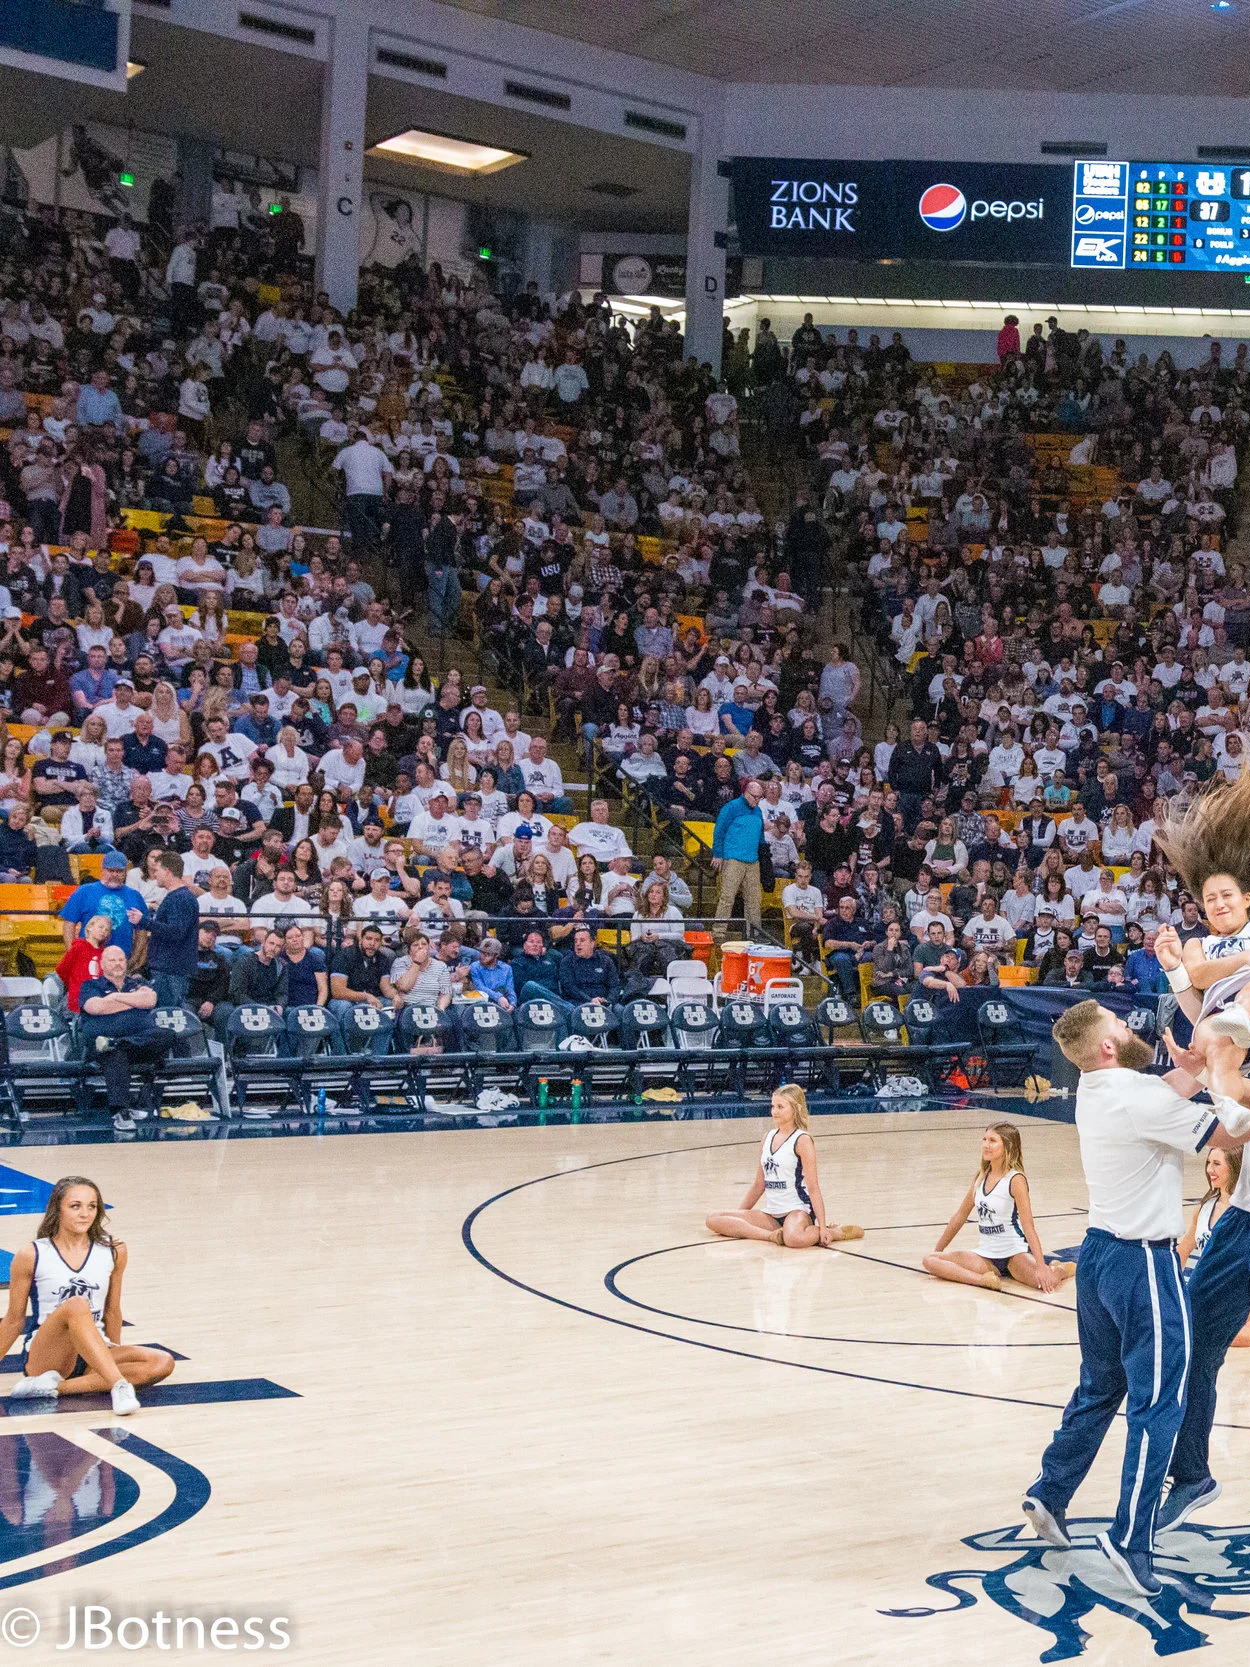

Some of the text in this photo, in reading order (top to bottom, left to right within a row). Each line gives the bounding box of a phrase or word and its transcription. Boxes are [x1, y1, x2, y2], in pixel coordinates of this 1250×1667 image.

[771, 180, 858, 205] ZIONS
[337, 197, 353, 216] C
[970, 198, 1044, 222] pepsi
[1156, 200, 1168, 210] 17
[770, 205, 856, 232] BANK
[705, 276, 717, 293] D
[540, 563, 560, 577] USU
